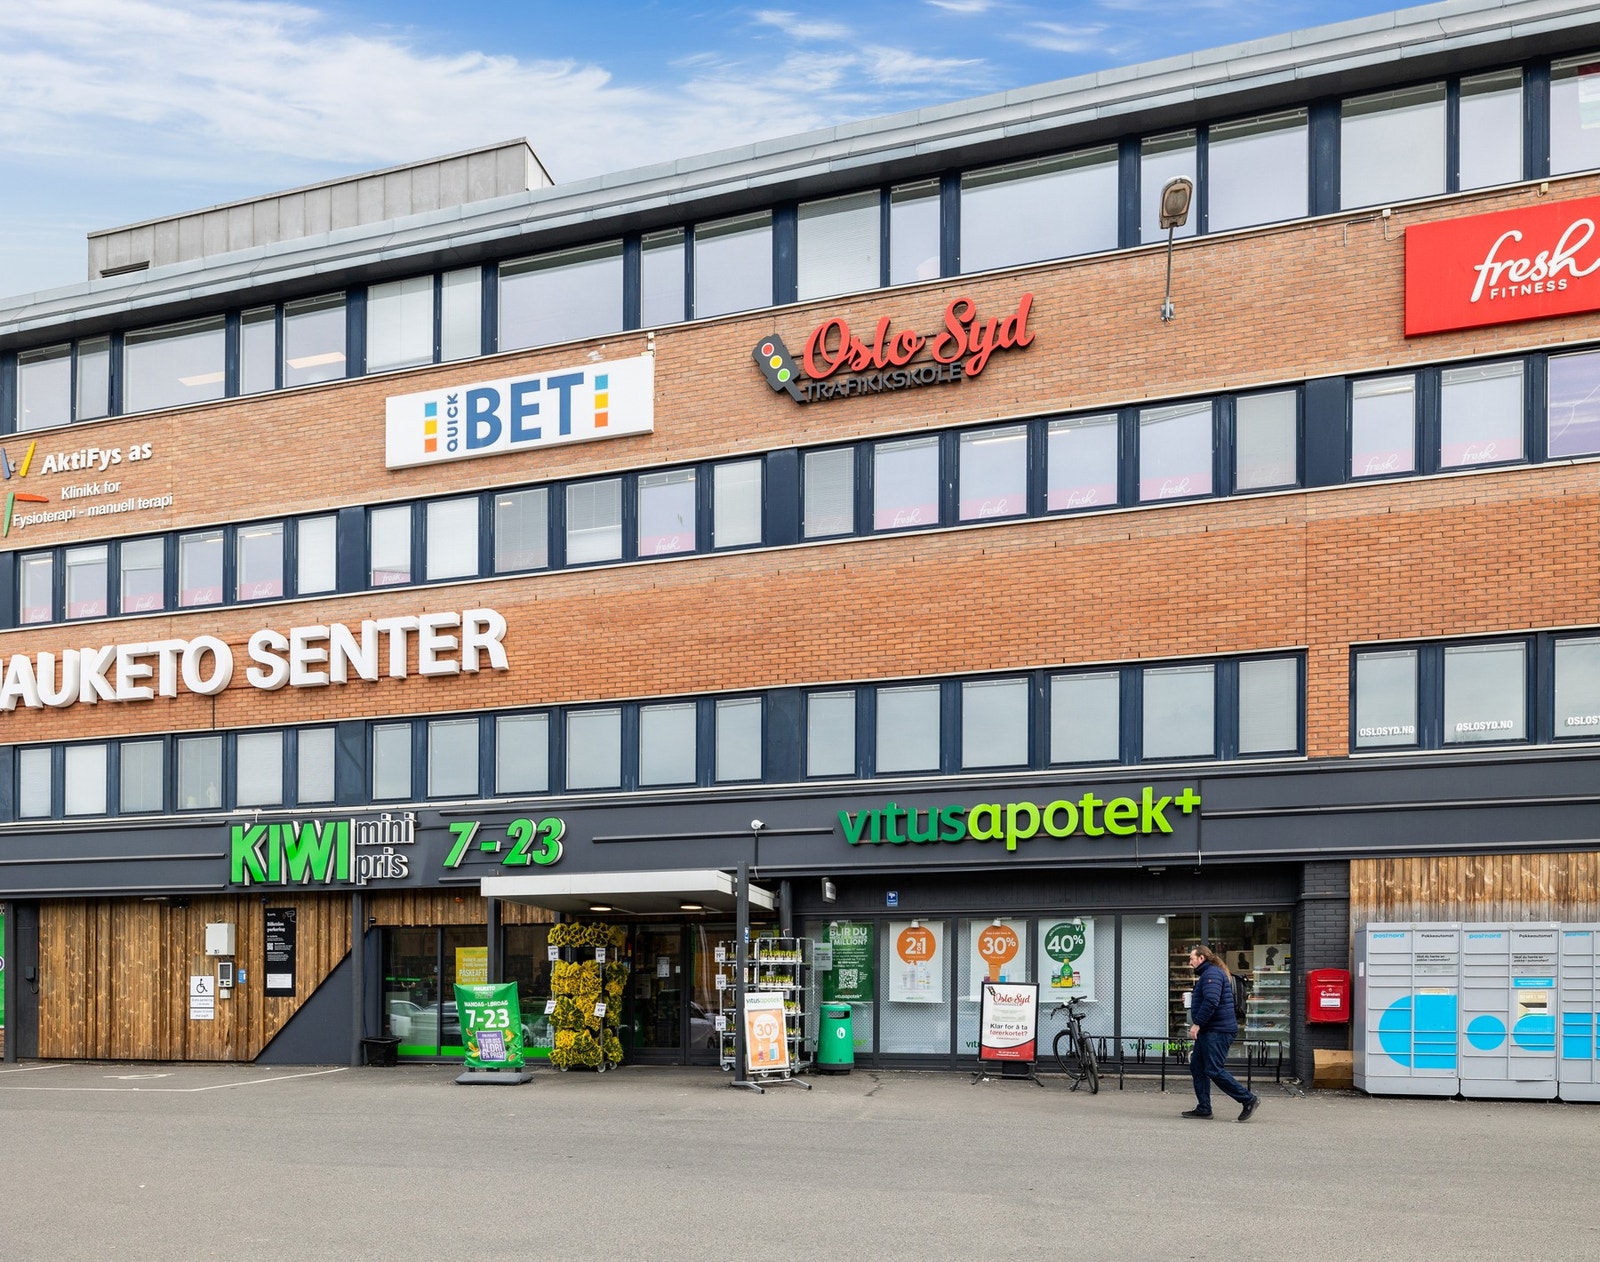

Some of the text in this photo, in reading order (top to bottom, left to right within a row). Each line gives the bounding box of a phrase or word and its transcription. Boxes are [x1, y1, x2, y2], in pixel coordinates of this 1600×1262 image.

[1470, 219, 1600, 303] fresh
[1490, 279, 1567, 300] FITNESS
[803, 293, 1036, 379] Oslo Syd
[805, 363, 963, 402] TRAFIKKSKOLE
[447, 393, 458, 452] QUICK
[466, 372, 584, 450] BET
[40, 442, 153, 475] AktiFys as
[61, 481, 122, 500] Klinikk for
[13, 507, 76, 529] Fysioterapi
[88, 500, 135, 517] manuell
[138, 492, 173, 511] terapi
[0, 609, 509, 711] AUKETO SENTER
[1360, 725, 1415, 737] OSLOSYD.NO
[1456, 720, 1514, 732] OSLOSYD.NO
[356, 812, 415, 844] mini
[231, 821, 350, 884] KIWI
[356, 847, 409, 885] pris
[852, 926, 867, 936] DU
[982, 936, 1016, 955] 30%
[1047, 934, 1084, 953] 40%
[465, 1008, 510, 1029] 7-23
